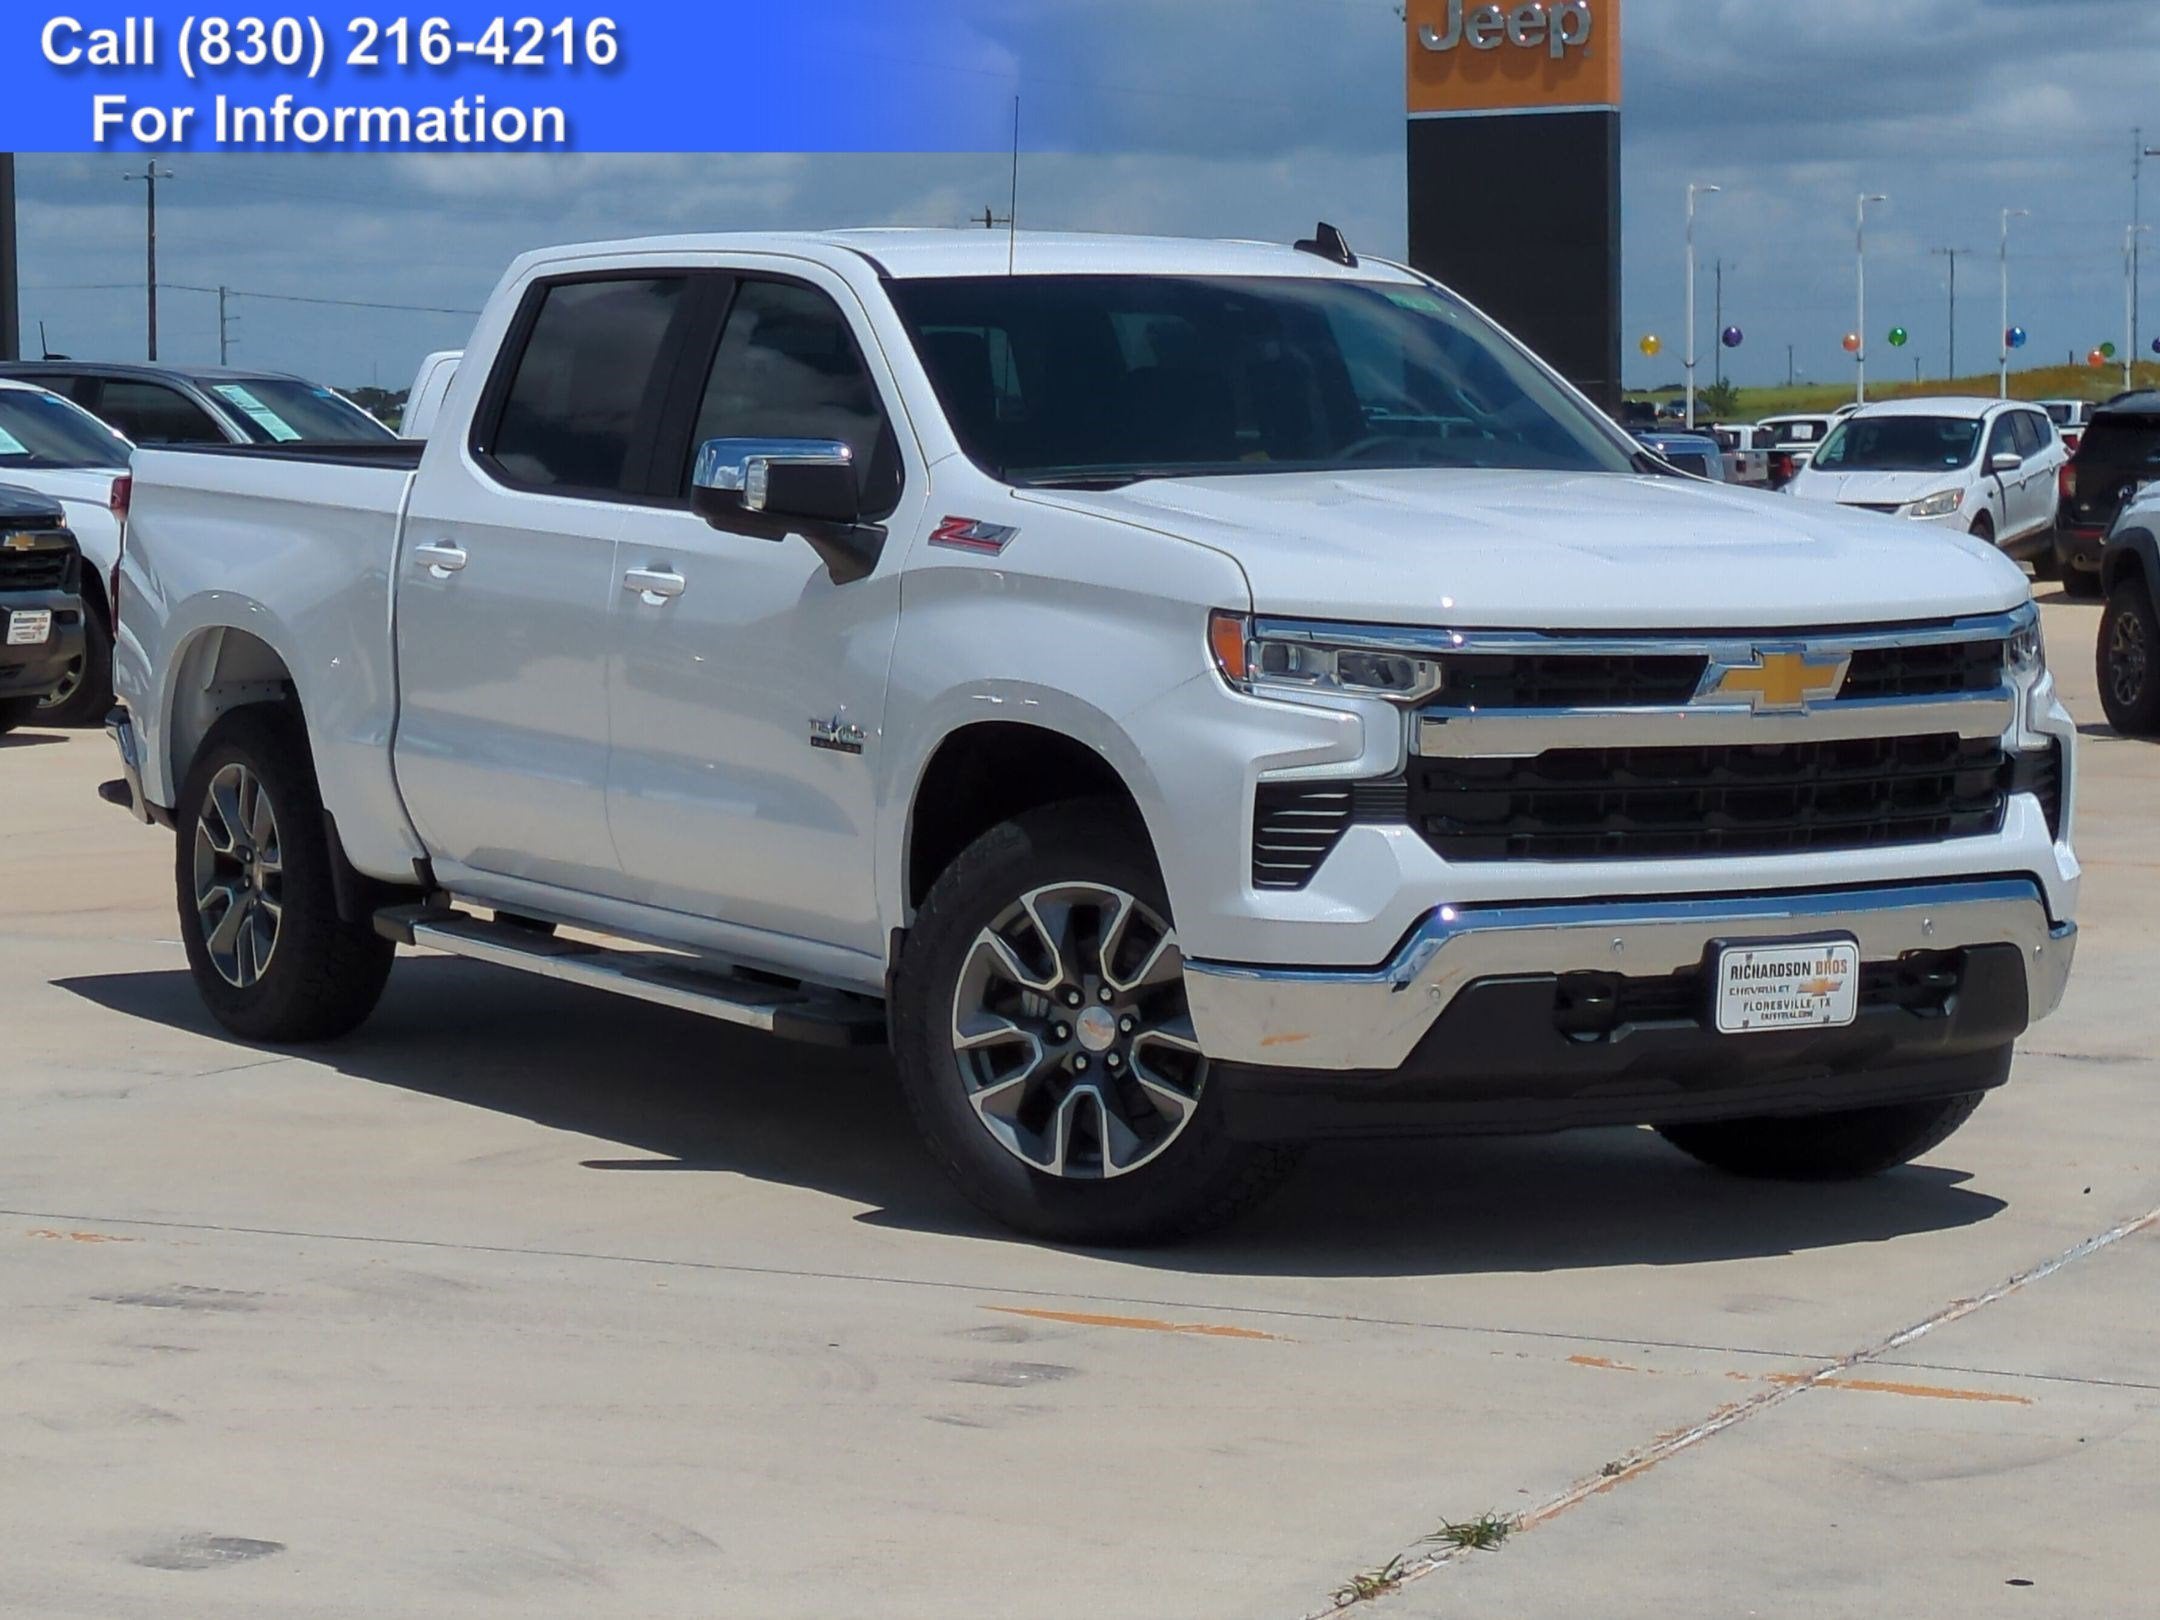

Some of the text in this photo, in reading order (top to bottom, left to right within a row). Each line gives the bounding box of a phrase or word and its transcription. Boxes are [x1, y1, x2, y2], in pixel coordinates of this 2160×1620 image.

[1418, 0, 1592, 58] Jeep
[1730, 959, 1848, 981] RICHARDSON BROS
